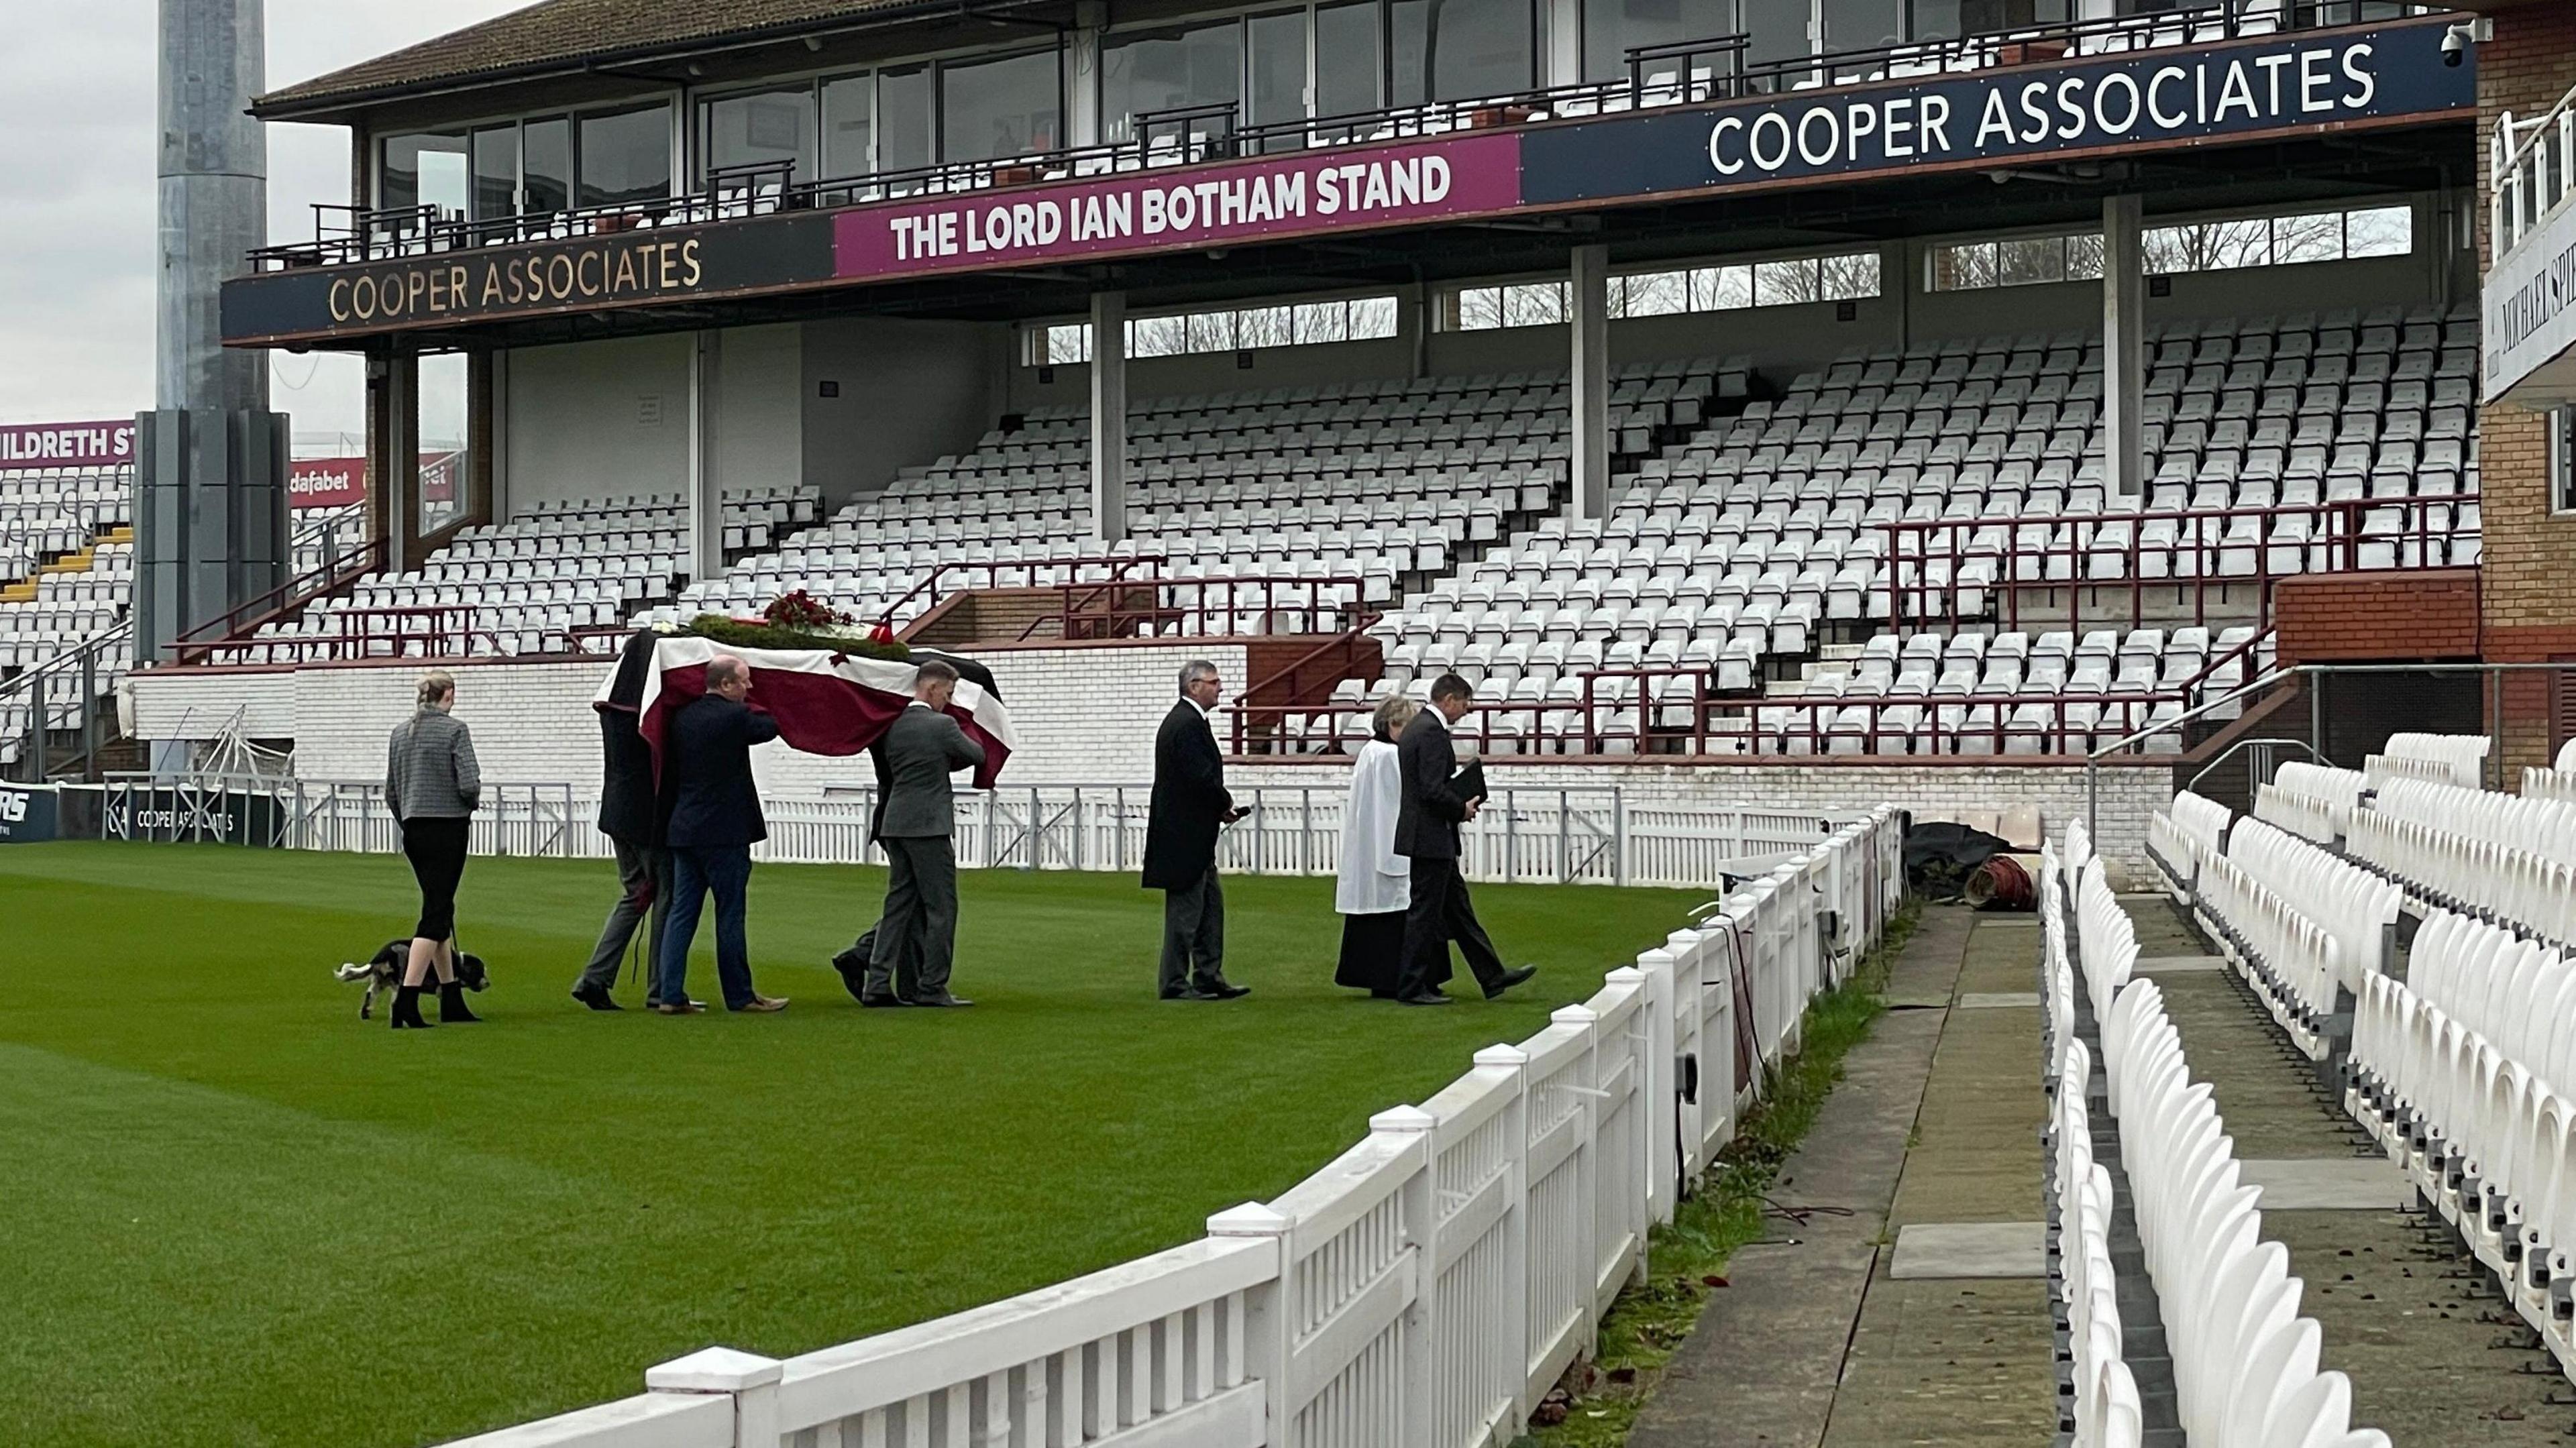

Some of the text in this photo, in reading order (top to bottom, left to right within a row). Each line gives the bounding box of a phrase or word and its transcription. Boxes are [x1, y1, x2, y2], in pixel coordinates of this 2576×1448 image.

[1711, 44, 2374, 174] COOPER ASSOCIATES
[890, 156, 1451, 260] THE LORD IAN BOTHAM STAND
[329, 239, 701, 321] COOPER ASSOCIATES
[2502, 268, 2549, 355] MICHAEL
[0, 429, 107, 460] ILDRETH
[290, 470, 349, 496] dafabet
[138, 810, 174, 828] COOPE
